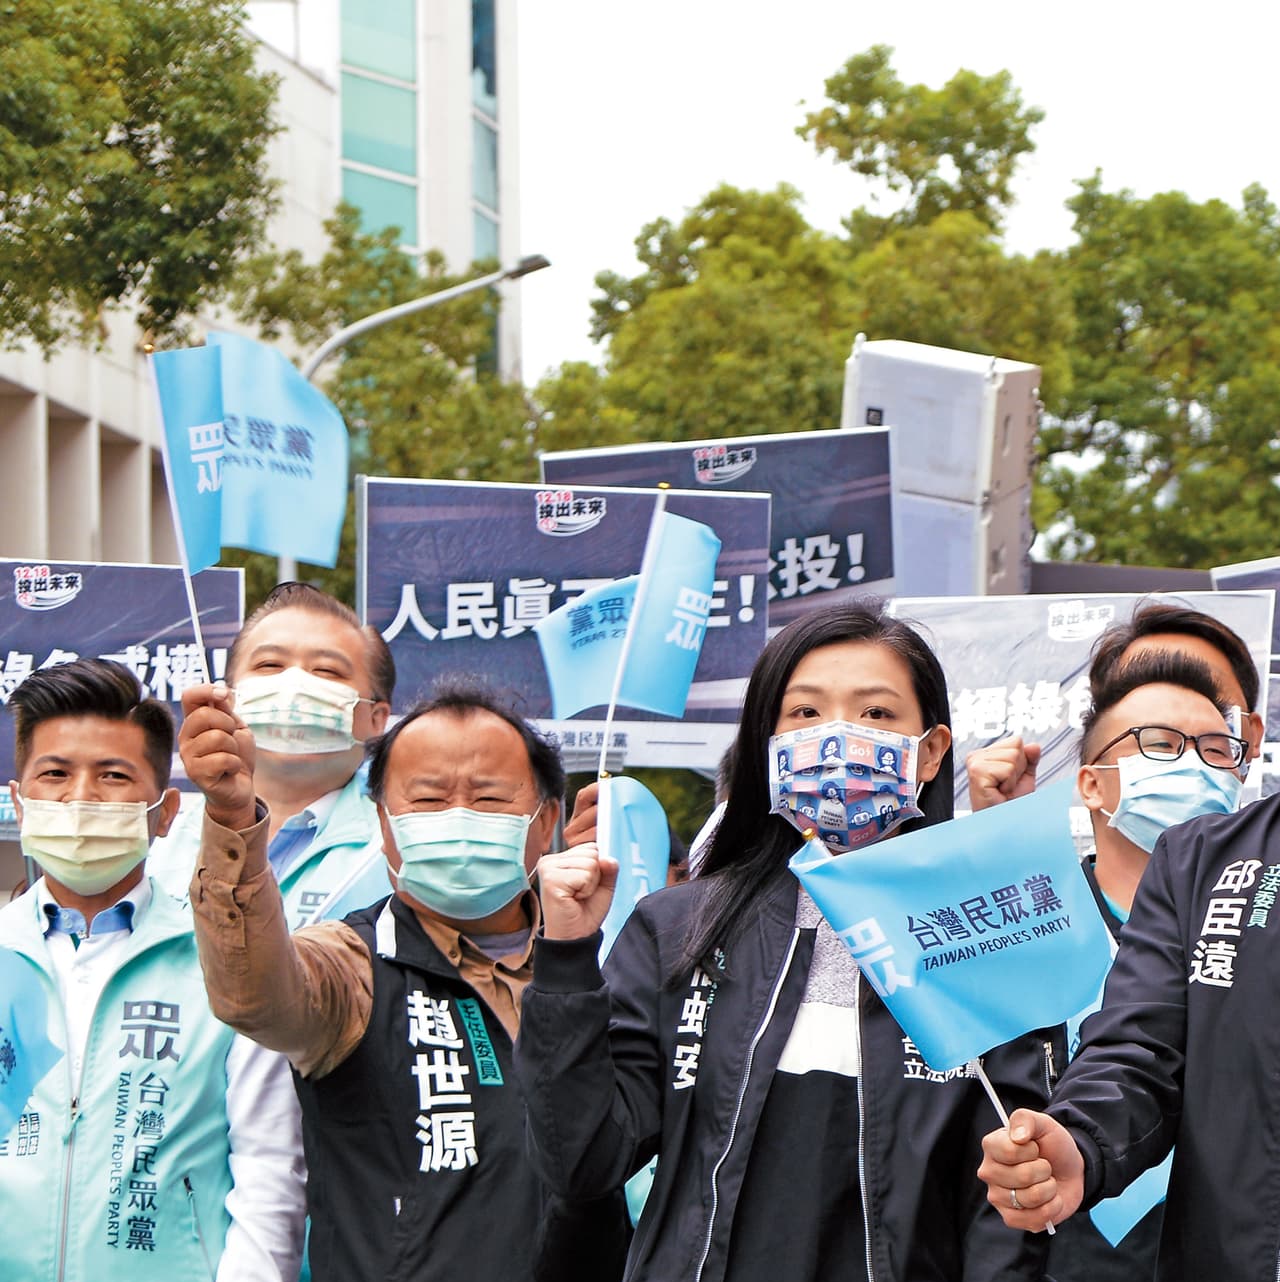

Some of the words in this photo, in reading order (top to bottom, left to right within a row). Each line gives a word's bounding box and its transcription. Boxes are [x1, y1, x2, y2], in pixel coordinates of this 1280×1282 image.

[538, 491, 571, 503] 12.18
[539, 500, 603, 519] 投出未來
[15, 566, 49, 578] 12.18
[17, 574, 81, 594] 投出未來
[769, 532, 865, 601] 投!
[906, 873, 1064, 951] 台灣民眾黨
[923, 945, 978, 971] TAIWAN
[979, 930, 1033, 956] PEOPLE'S
[1035, 914, 1072, 939] PARTY
[1188, 858, 1260, 989] 邱臣遠
[119, 1000, 181, 1063] 眾
[462, 1003, 500, 1081] 主任委員
[112, 1070, 132, 1129] TAIWAN
[407, 990, 480, 1172] 趙世源
[108, 1134, 125, 1196] PEOPLE'S
[126, 1071, 170, 1252] 台灣民眾黨
[106, 1201, 121, 1249] PARTY
